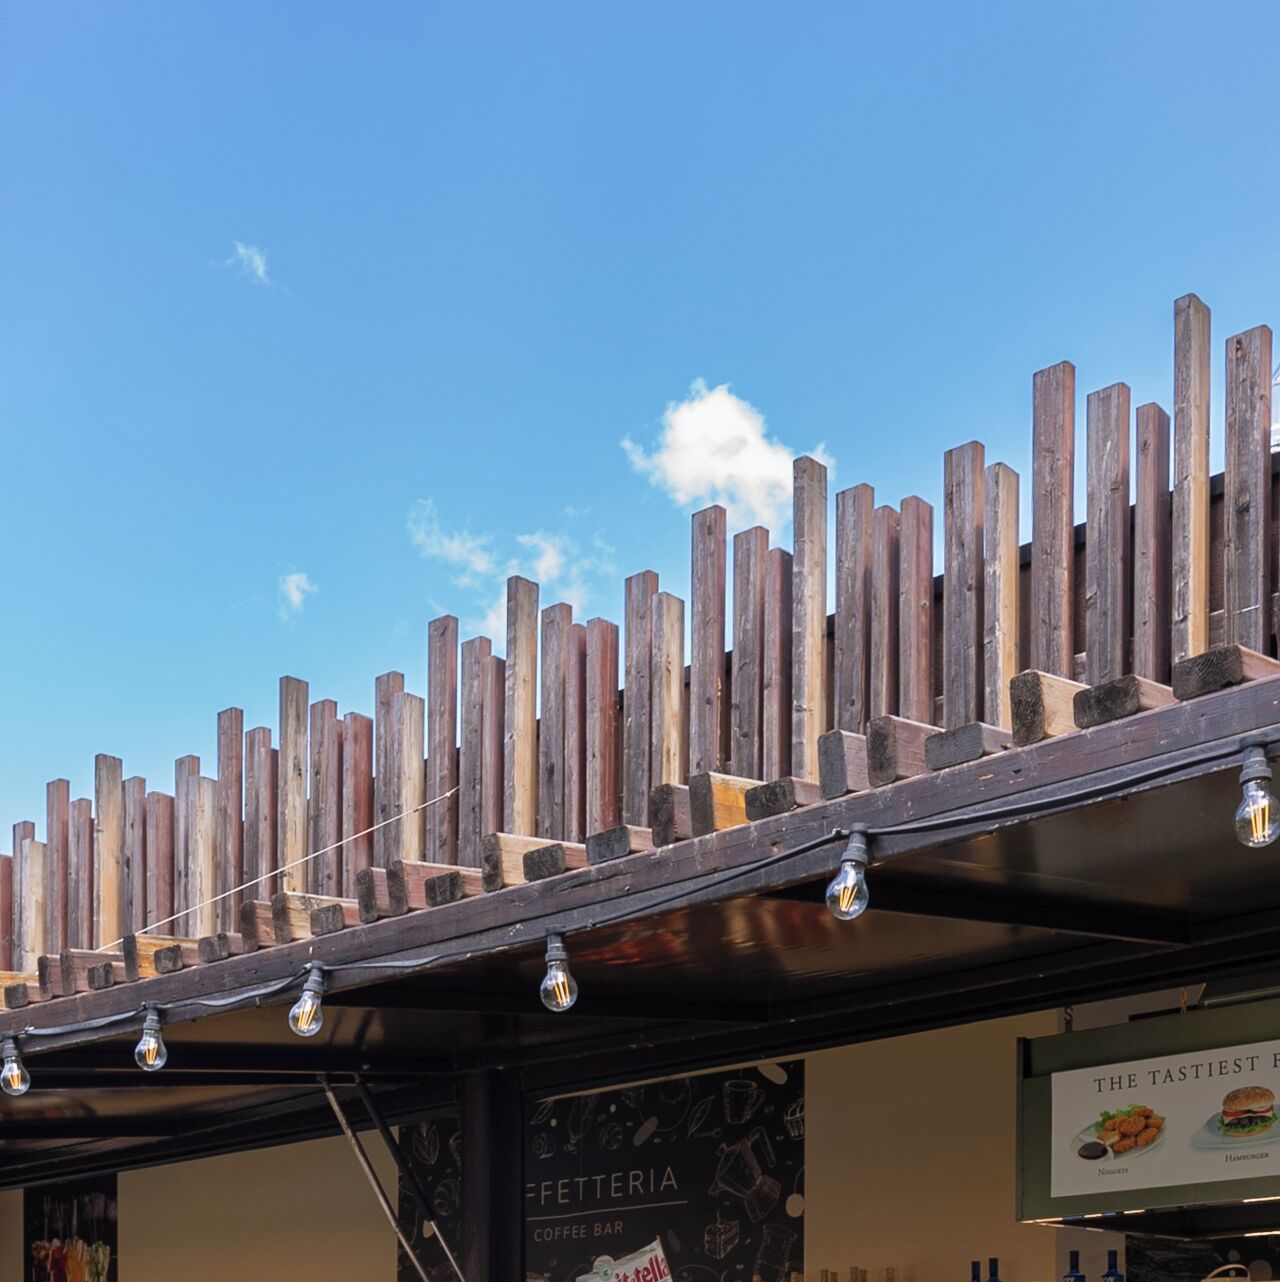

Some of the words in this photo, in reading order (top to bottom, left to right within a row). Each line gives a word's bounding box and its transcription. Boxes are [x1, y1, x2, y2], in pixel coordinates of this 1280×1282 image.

[1094, 1074, 1138, 1093] THE
[1148, 1055, 1260, 1085] TASTIEST
[534, 1224, 588, 1242] COFFEE
[593, 1220, 624, 1237] BAR
